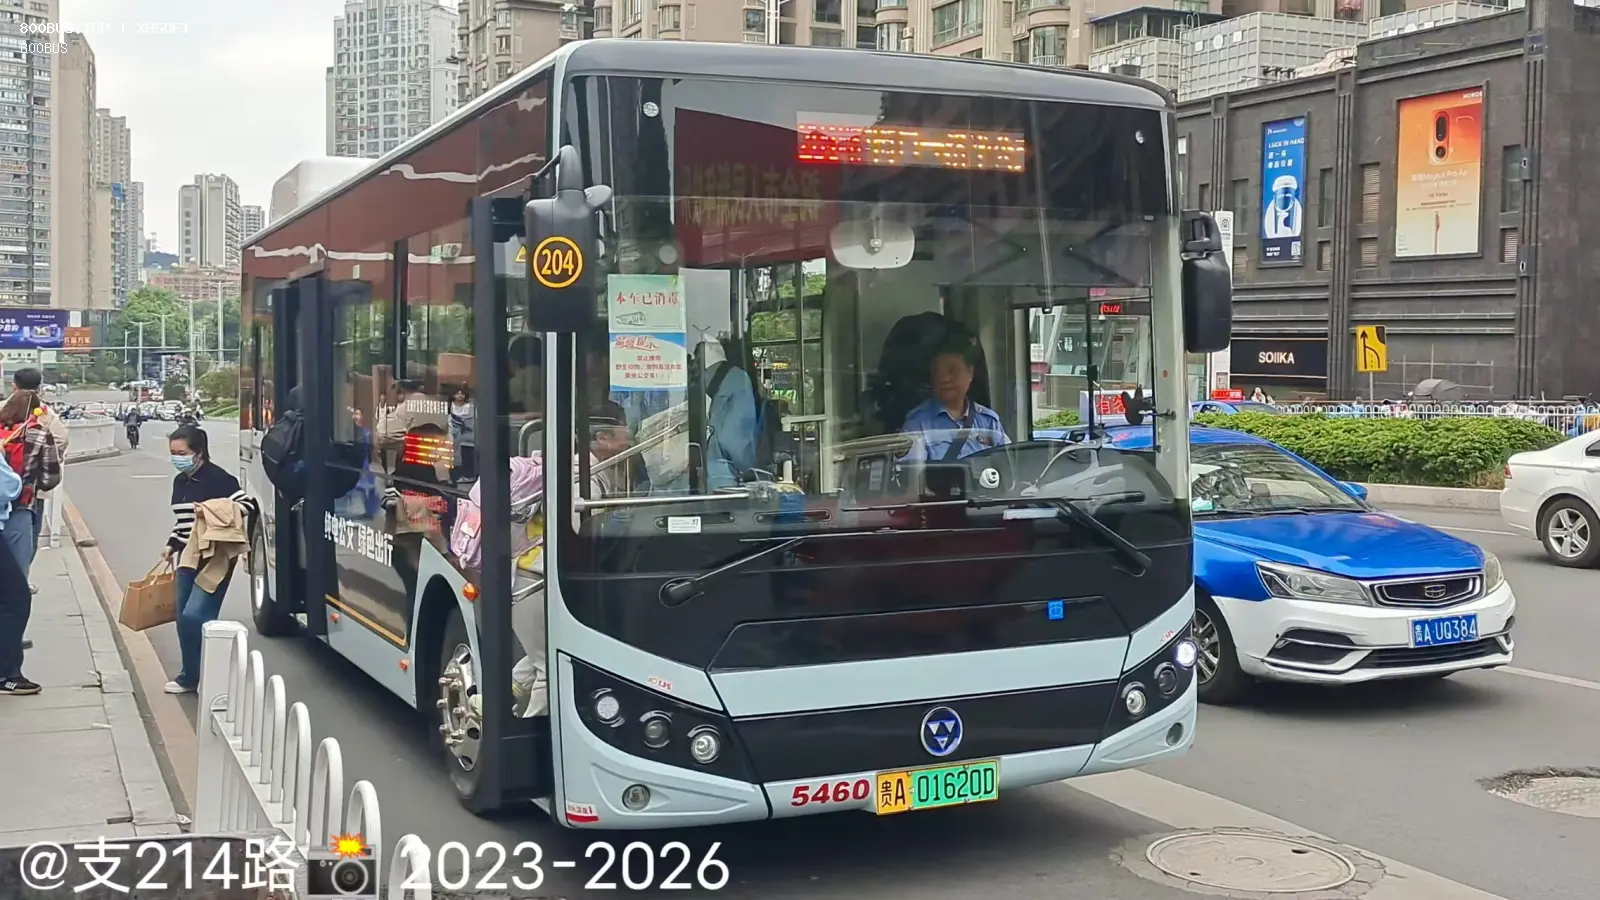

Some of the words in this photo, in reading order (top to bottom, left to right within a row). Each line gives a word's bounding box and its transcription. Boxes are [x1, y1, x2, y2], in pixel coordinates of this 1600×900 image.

[541, 249, 575, 276] 204
[616, 291, 680, 305] 本车已消毒
[357, 522, 394, 568] 绿色出行
[791, 779, 870, 807] 5460
